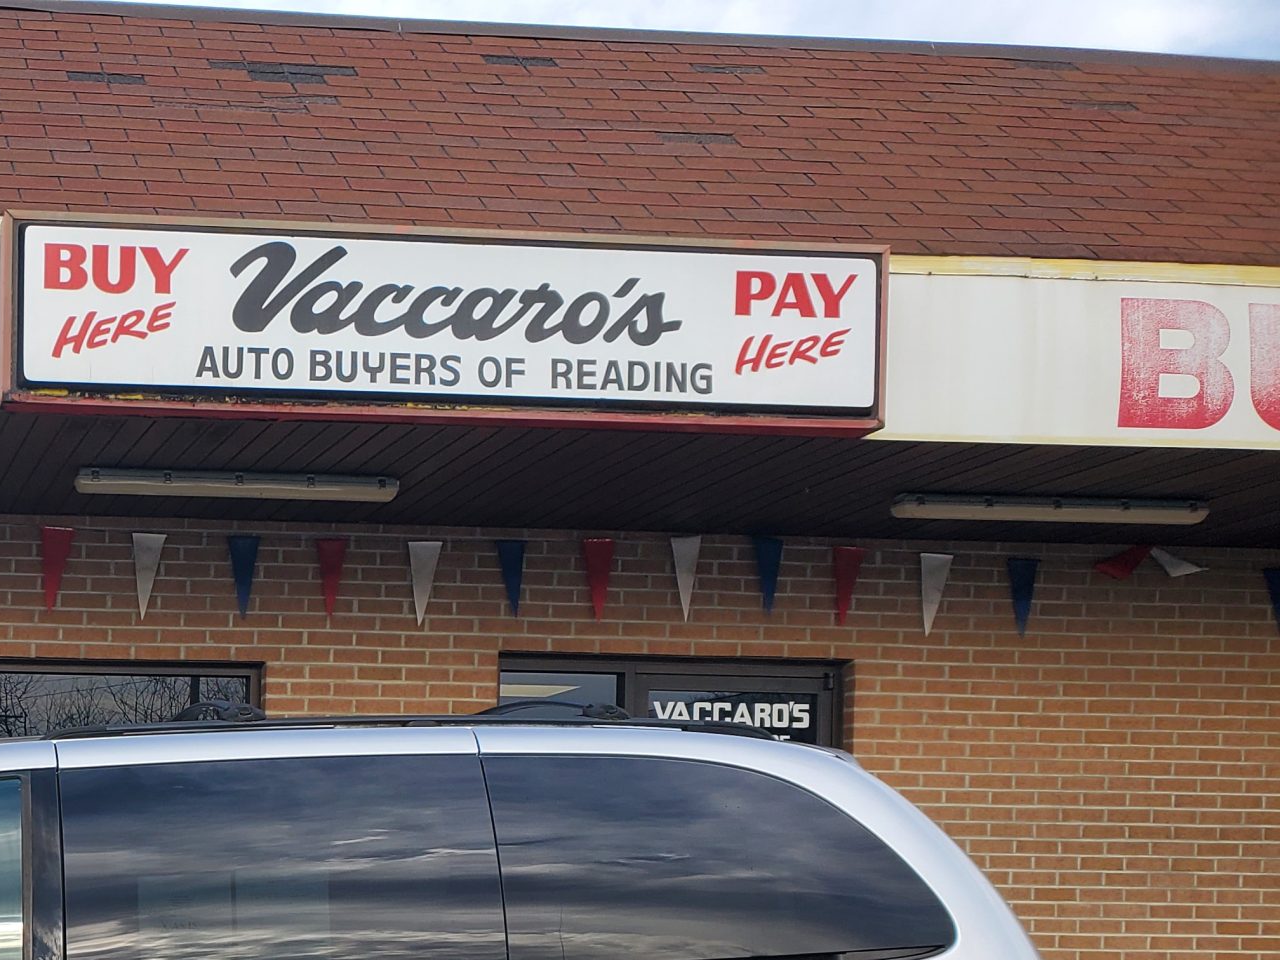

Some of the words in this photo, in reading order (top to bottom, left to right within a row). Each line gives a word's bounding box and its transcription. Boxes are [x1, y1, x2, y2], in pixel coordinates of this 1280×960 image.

[44, 242, 190, 294] BUY
[229, 240, 683, 347] Vaccaro's
[734, 270, 858, 319] PAY
[51, 300, 176, 359] HERE
[734, 328, 850, 375] HERE
[195, 345, 295, 381] AUTO
[309, 348, 462, 388] BUYERS
[478, 355, 526, 389] OF
[550, 357, 713, 395] READING
[652, 700, 811, 729] VACCARO'S
